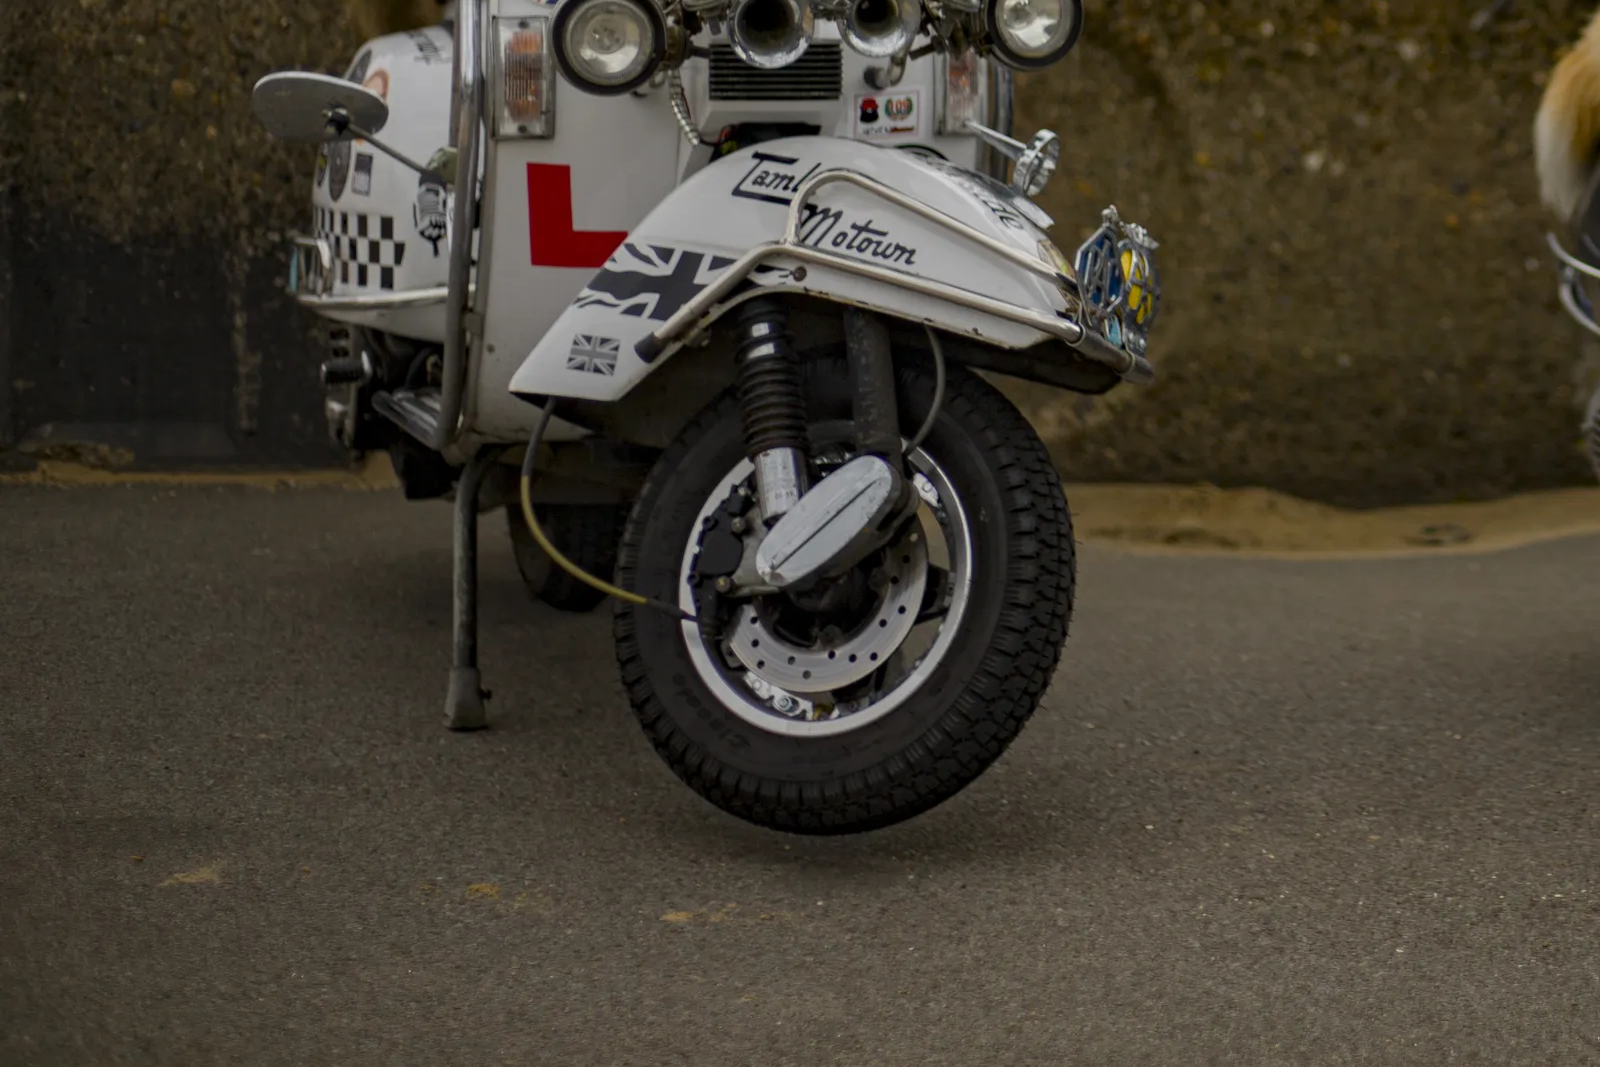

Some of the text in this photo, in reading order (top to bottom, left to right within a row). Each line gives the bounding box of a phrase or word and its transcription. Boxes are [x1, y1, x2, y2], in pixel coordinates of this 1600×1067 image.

[731, 151, 823, 208] Taml
[526, 162, 629, 269] L
[799, 202, 918, 265] Motown
